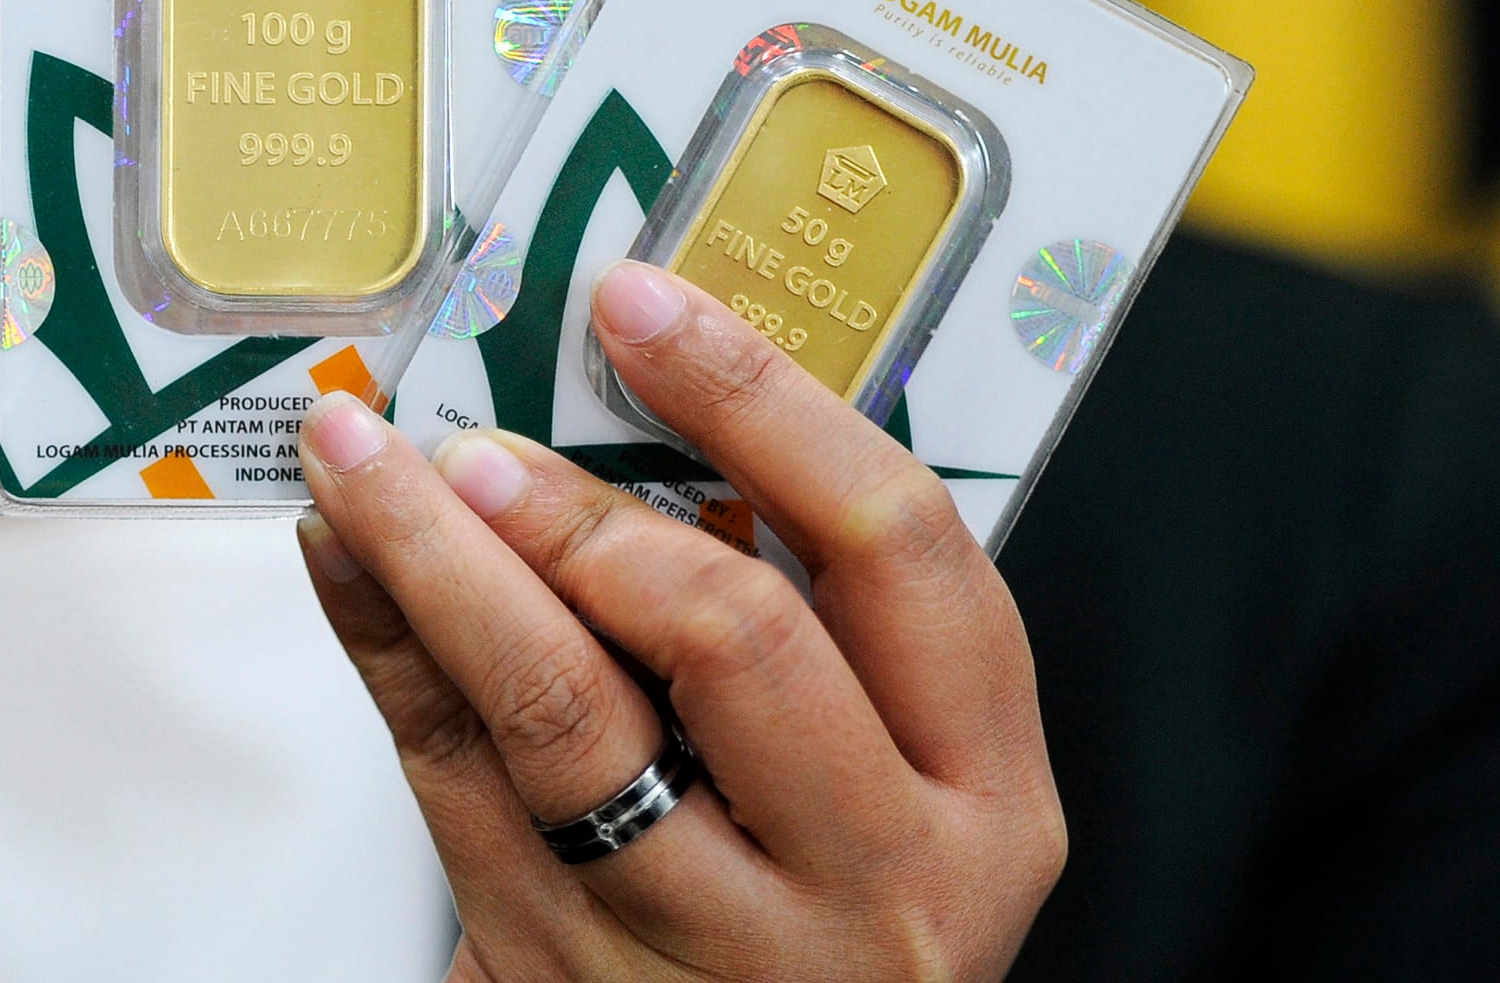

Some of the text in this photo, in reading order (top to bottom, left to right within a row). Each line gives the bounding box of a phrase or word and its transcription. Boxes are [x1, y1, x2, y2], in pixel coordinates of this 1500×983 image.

[241, 12, 351, 55] 100 g
[874, 3, 1013, 86] Purity is reliable
[964, 24, 1048, 84] MULIA
[187, 71, 405, 105] FINE GOLD
[239, 132, 352, 166] 999.9
[824, 168, 869, 203] LM
[781, 205, 854, 267] 50 g
[707, 219, 878, 332] FINE GOLD
[730, 294, 808, 352] 999.9
[219, 397, 314, 411] PRODUCED
[178, 420, 198, 434] PT
[202, 420, 264, 434] ANTAM
[36, 445, 299, 459] LOGAM MULIA PROCESSING AN
[235, 467, 305, 482] INDONE
[706, 499, 730, 517] BY
